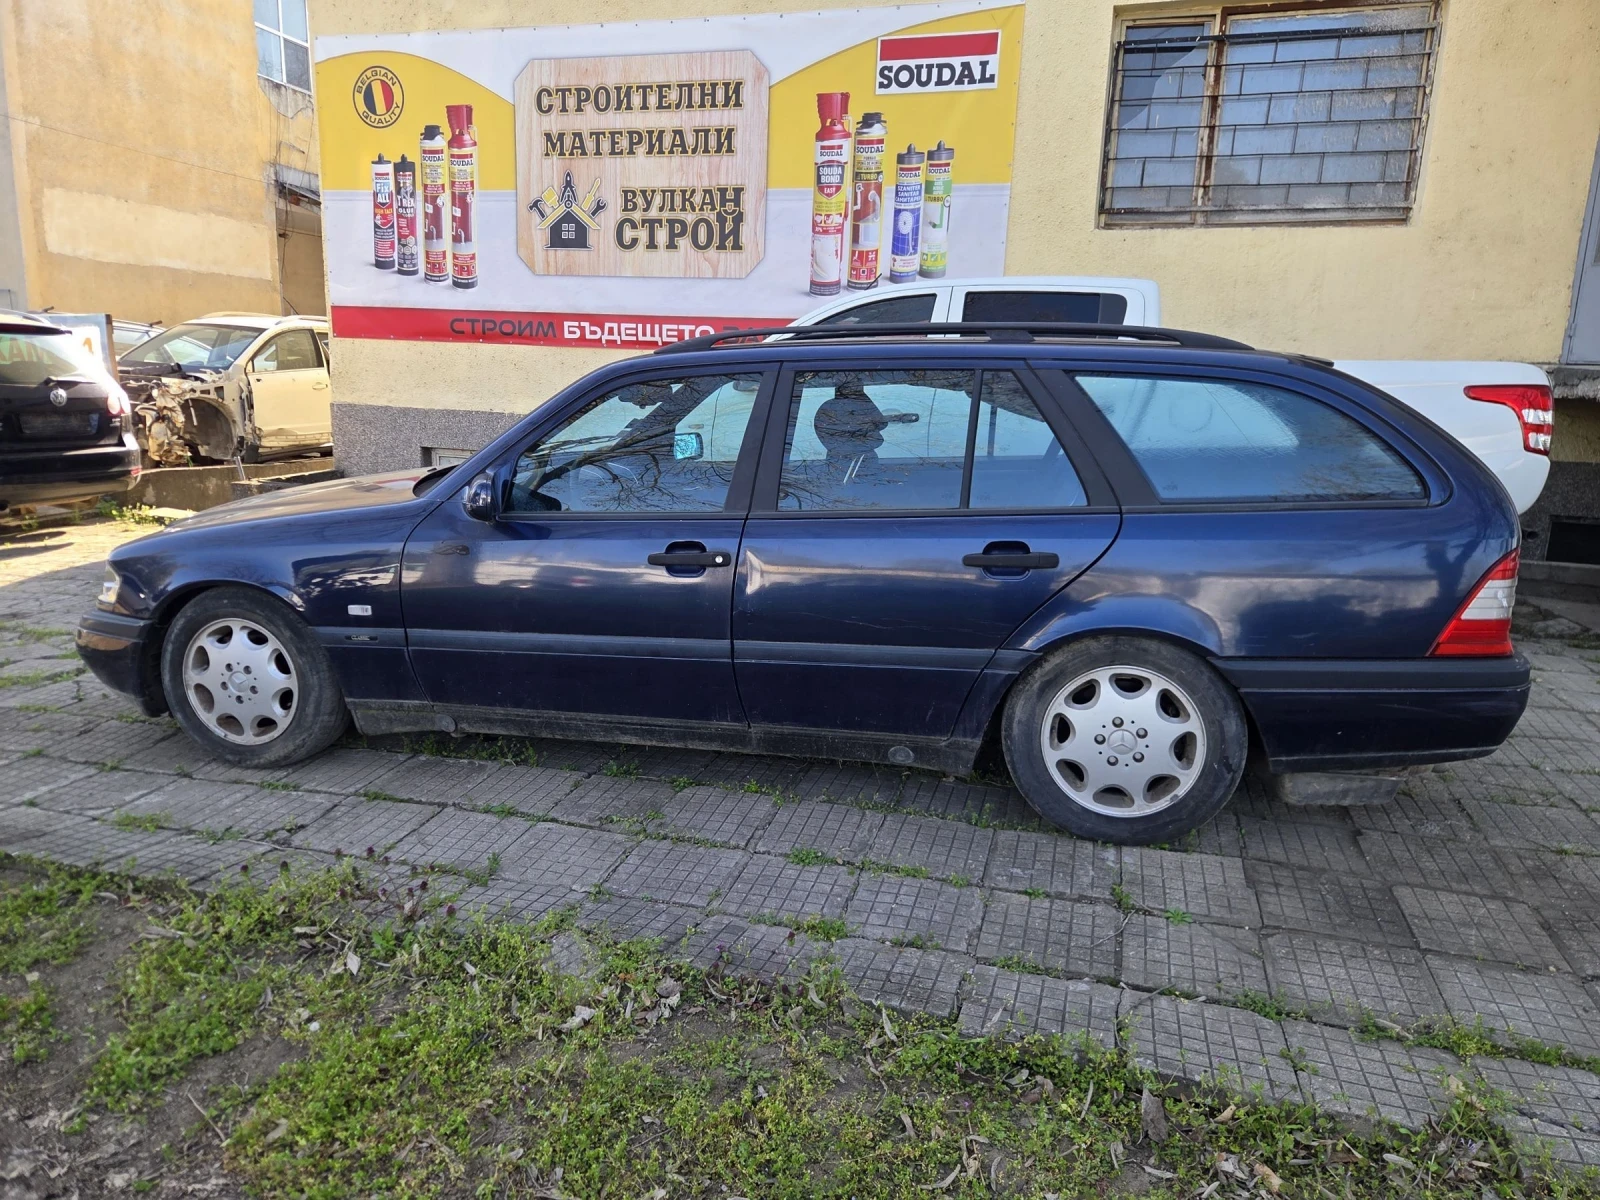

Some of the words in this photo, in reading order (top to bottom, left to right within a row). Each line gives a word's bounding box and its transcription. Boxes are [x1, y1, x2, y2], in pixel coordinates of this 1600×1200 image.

[356, 70, 397, 94] BELGIAN
[878, 60, 996, 89] SOUDAL
[536, 80, 744, 115] СТРОИТЕЛНИ
[362, 102, 400, 125] QUALITY
[543, 126, 736, 158] МАТЕРИАЛИ
[856, 146, 884, 154] SOUDAL
[450, 159, 473, 167] SOUDAL
[819, 166, 842, 175] SOUDA
[377, 193, 390, 203] ALL
[620, 185, 745, 213] ВУЛКАН
[615, 208, 745, 252] СТРОЙ
[450, 317, 557, 339] СТРОИМ
